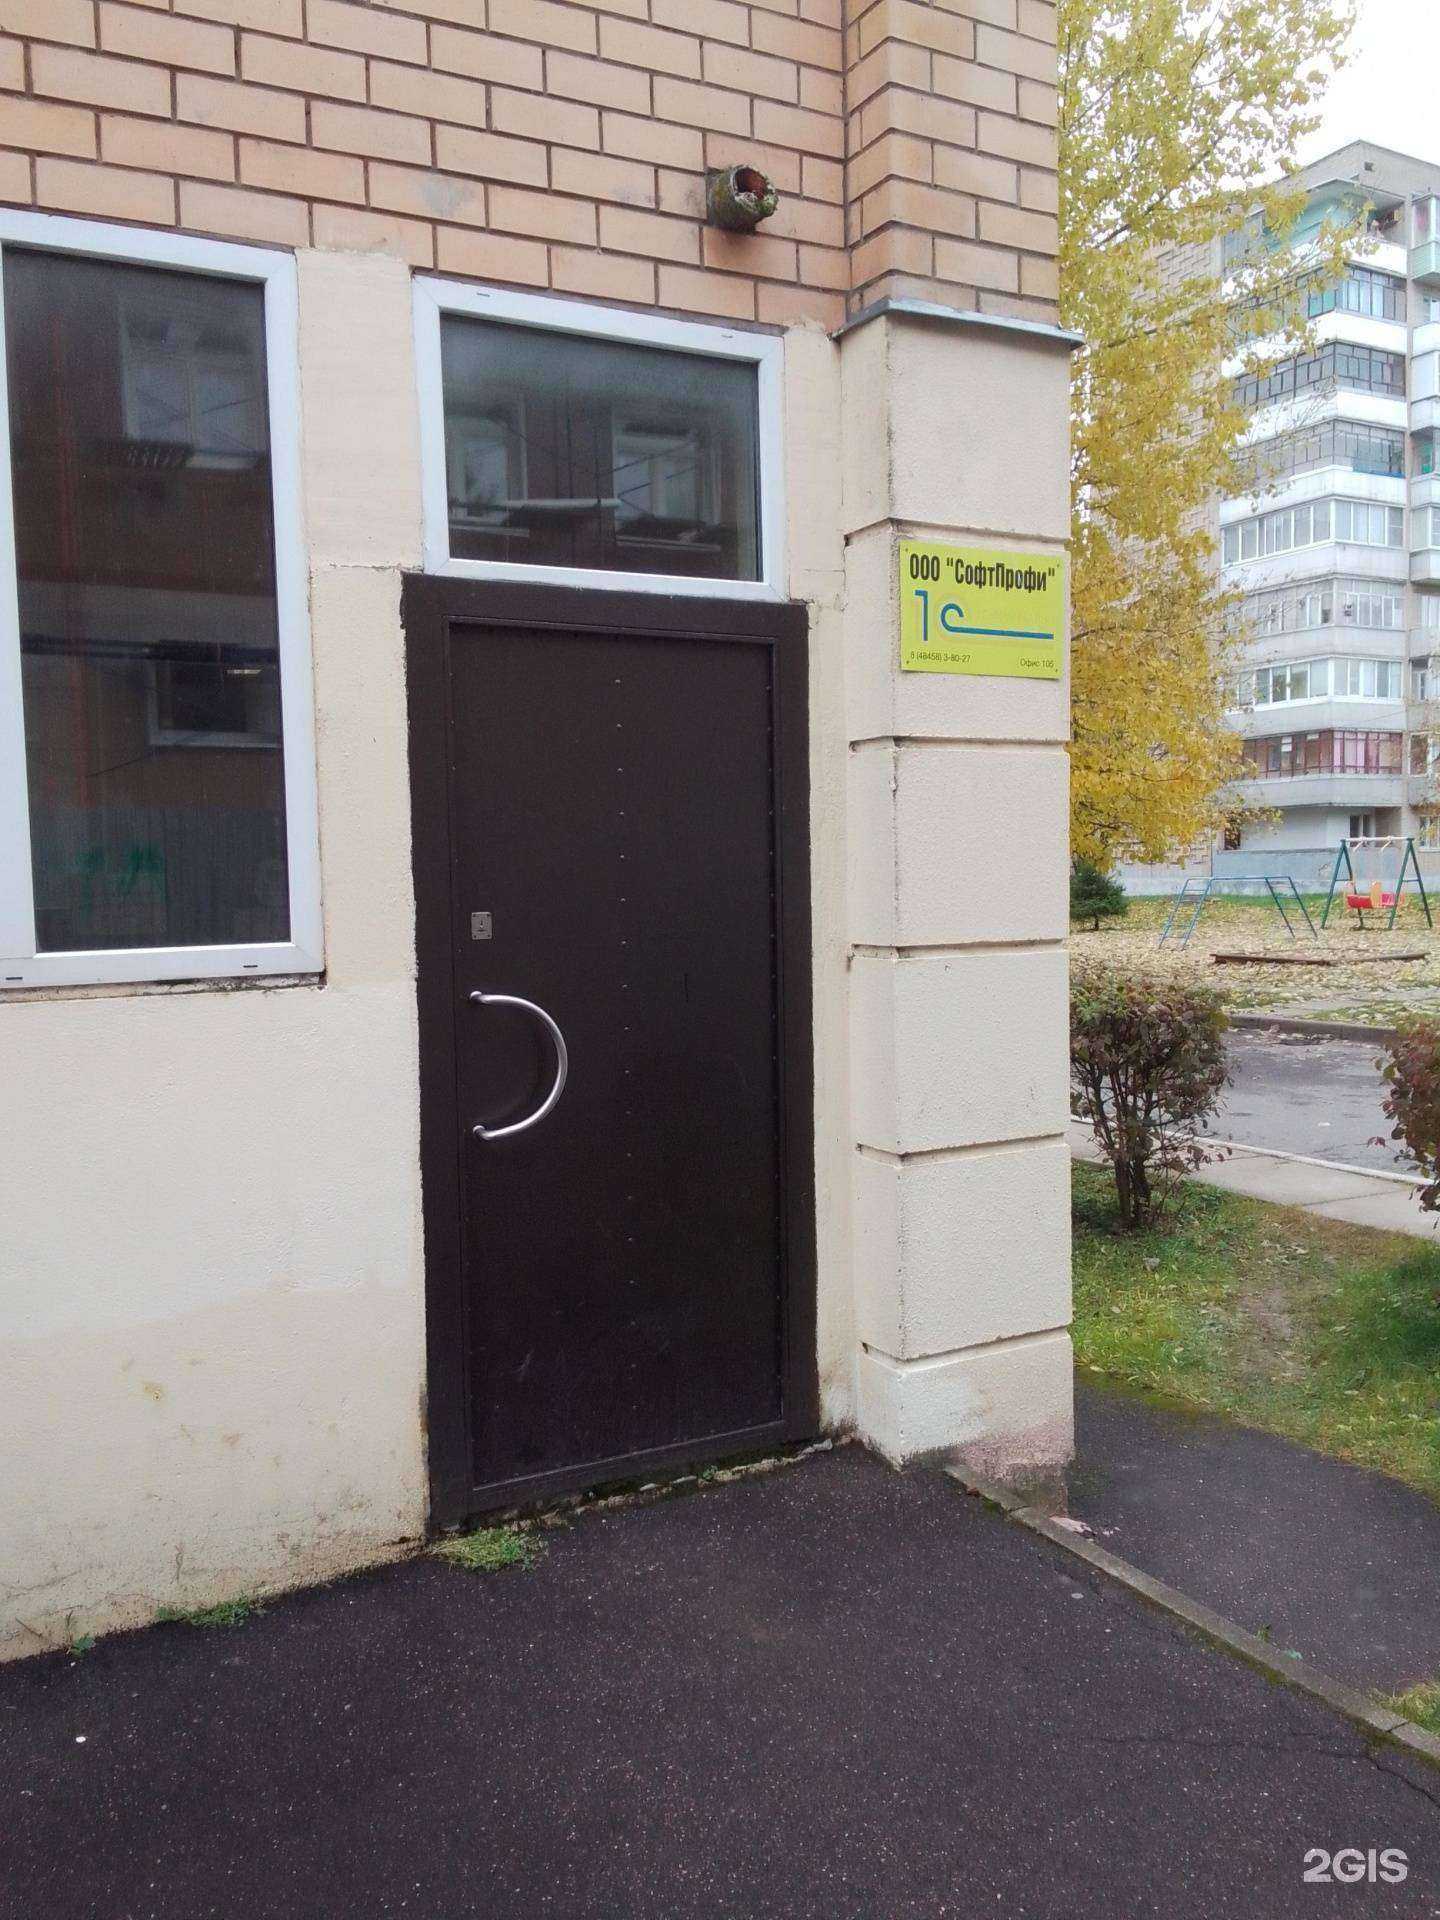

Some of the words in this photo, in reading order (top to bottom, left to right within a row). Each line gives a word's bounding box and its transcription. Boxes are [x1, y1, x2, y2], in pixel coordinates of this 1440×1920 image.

[909, 553, 940, 582] ООО
[946, 557, 1055, 593] "СофтПрофи"
[1019, 657, 1041, 669] Офис
